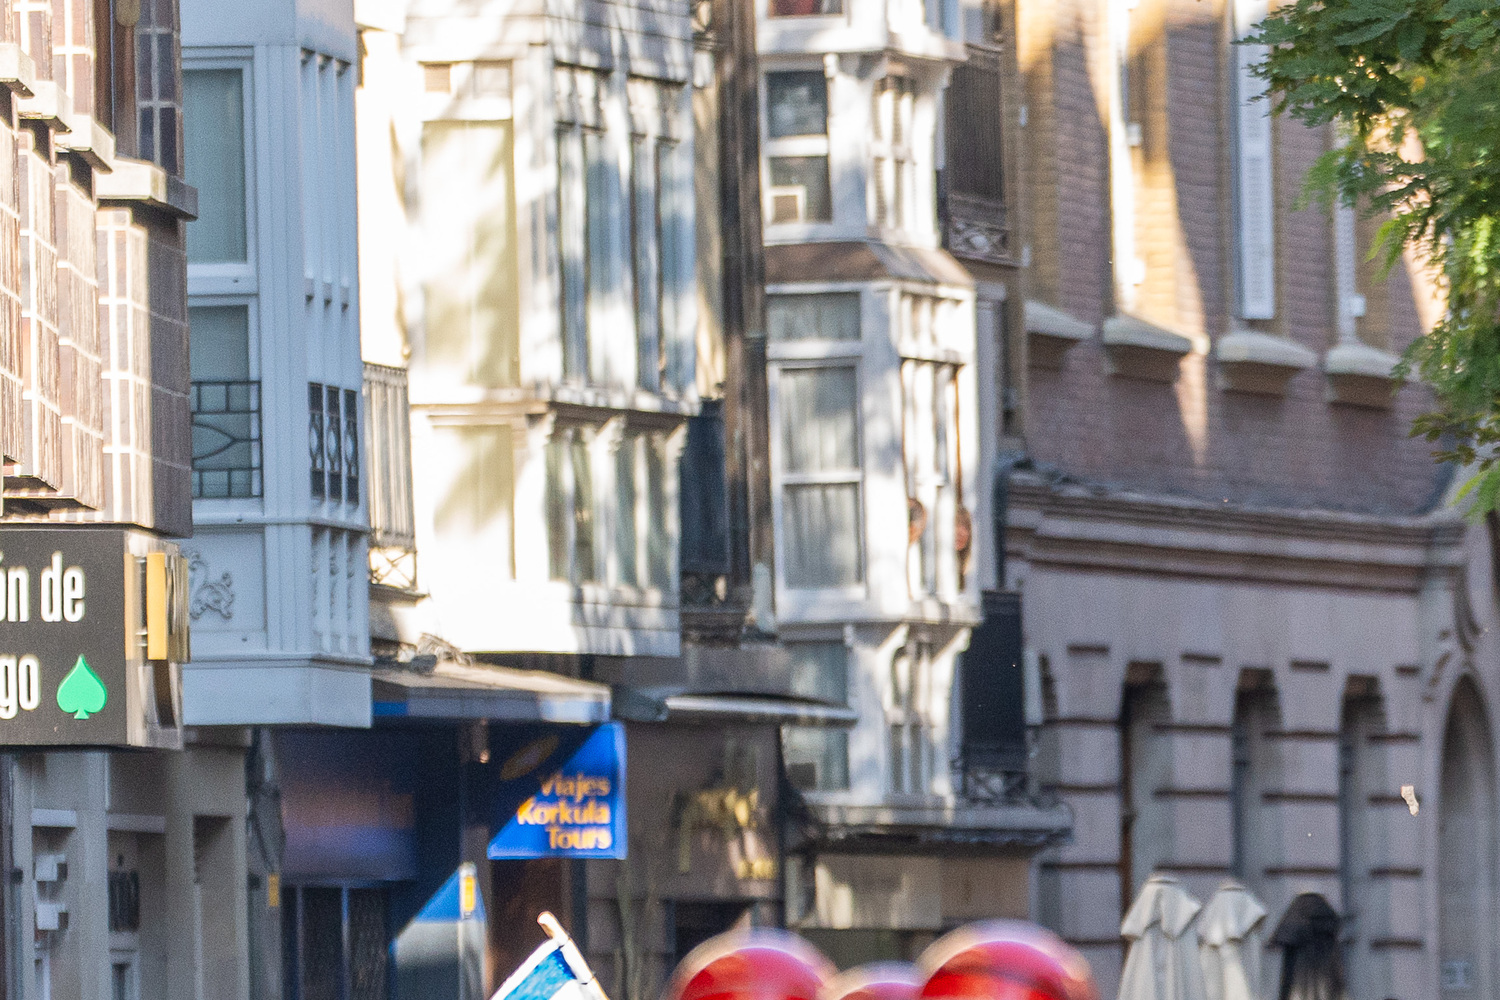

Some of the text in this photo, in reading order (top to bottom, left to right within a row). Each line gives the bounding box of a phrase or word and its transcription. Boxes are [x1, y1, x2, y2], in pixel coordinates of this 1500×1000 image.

[40, 550, 86, 623] de
[540, 770, 611, 802] Viajes
[517, 796, 611, 825] Korkula
[546, 825, 612, 850] Tours
